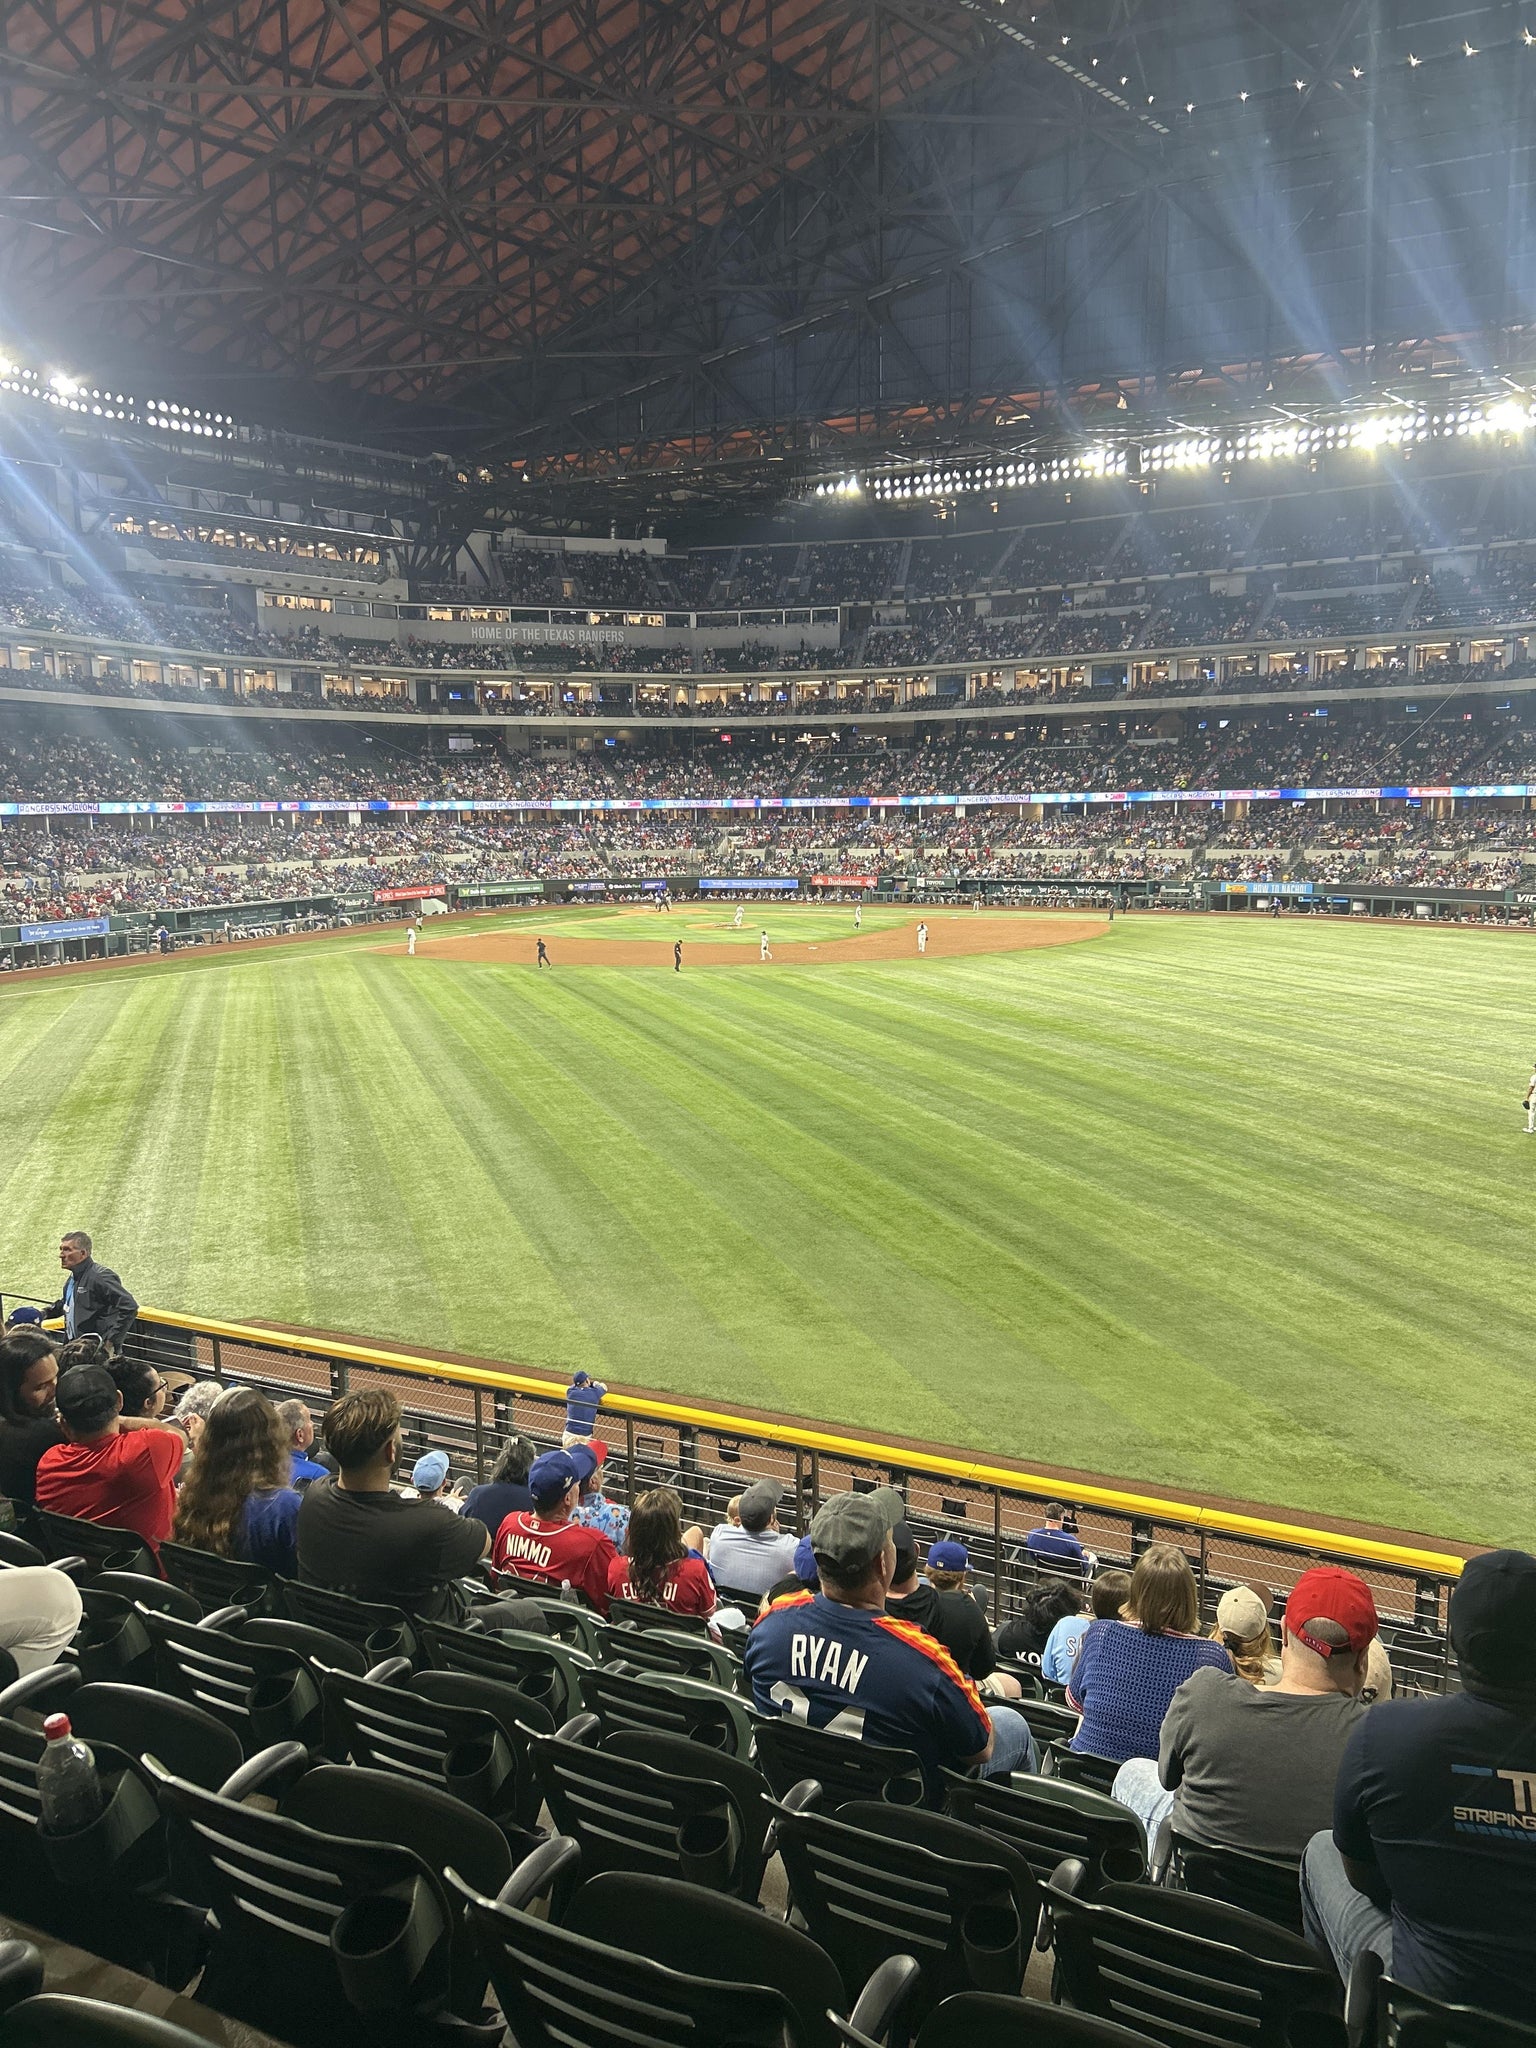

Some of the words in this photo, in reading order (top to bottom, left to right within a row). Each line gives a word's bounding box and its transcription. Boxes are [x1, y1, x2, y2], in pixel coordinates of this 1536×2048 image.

[471, 626, 501, 639] HOME
[505, 627, 518, 640] OF
[521, 628, 540, 641] THE
[543, 628, 575, 641] TEXAS
[578, 629, 624, 643] RANGERS
[1357, 788, 1380, 796] LONG
[19, 804, 55, 814] RANGERS
[55, 804, 73, 813] SING
[74, 803, 98, 813] ALONG
[827, 877, 862, 886] Budweiser
[1253, 883, 1269, 893] HOW
[1271, 884, 1280, 893] TO
[1281, 884, 1307, 894] NACHO!
[506, 1533, 552, 1568] NIMMO
[791, 1634, 869, 1695] RYAN
[1453, 1806, 1536, 1830] STRIPING
